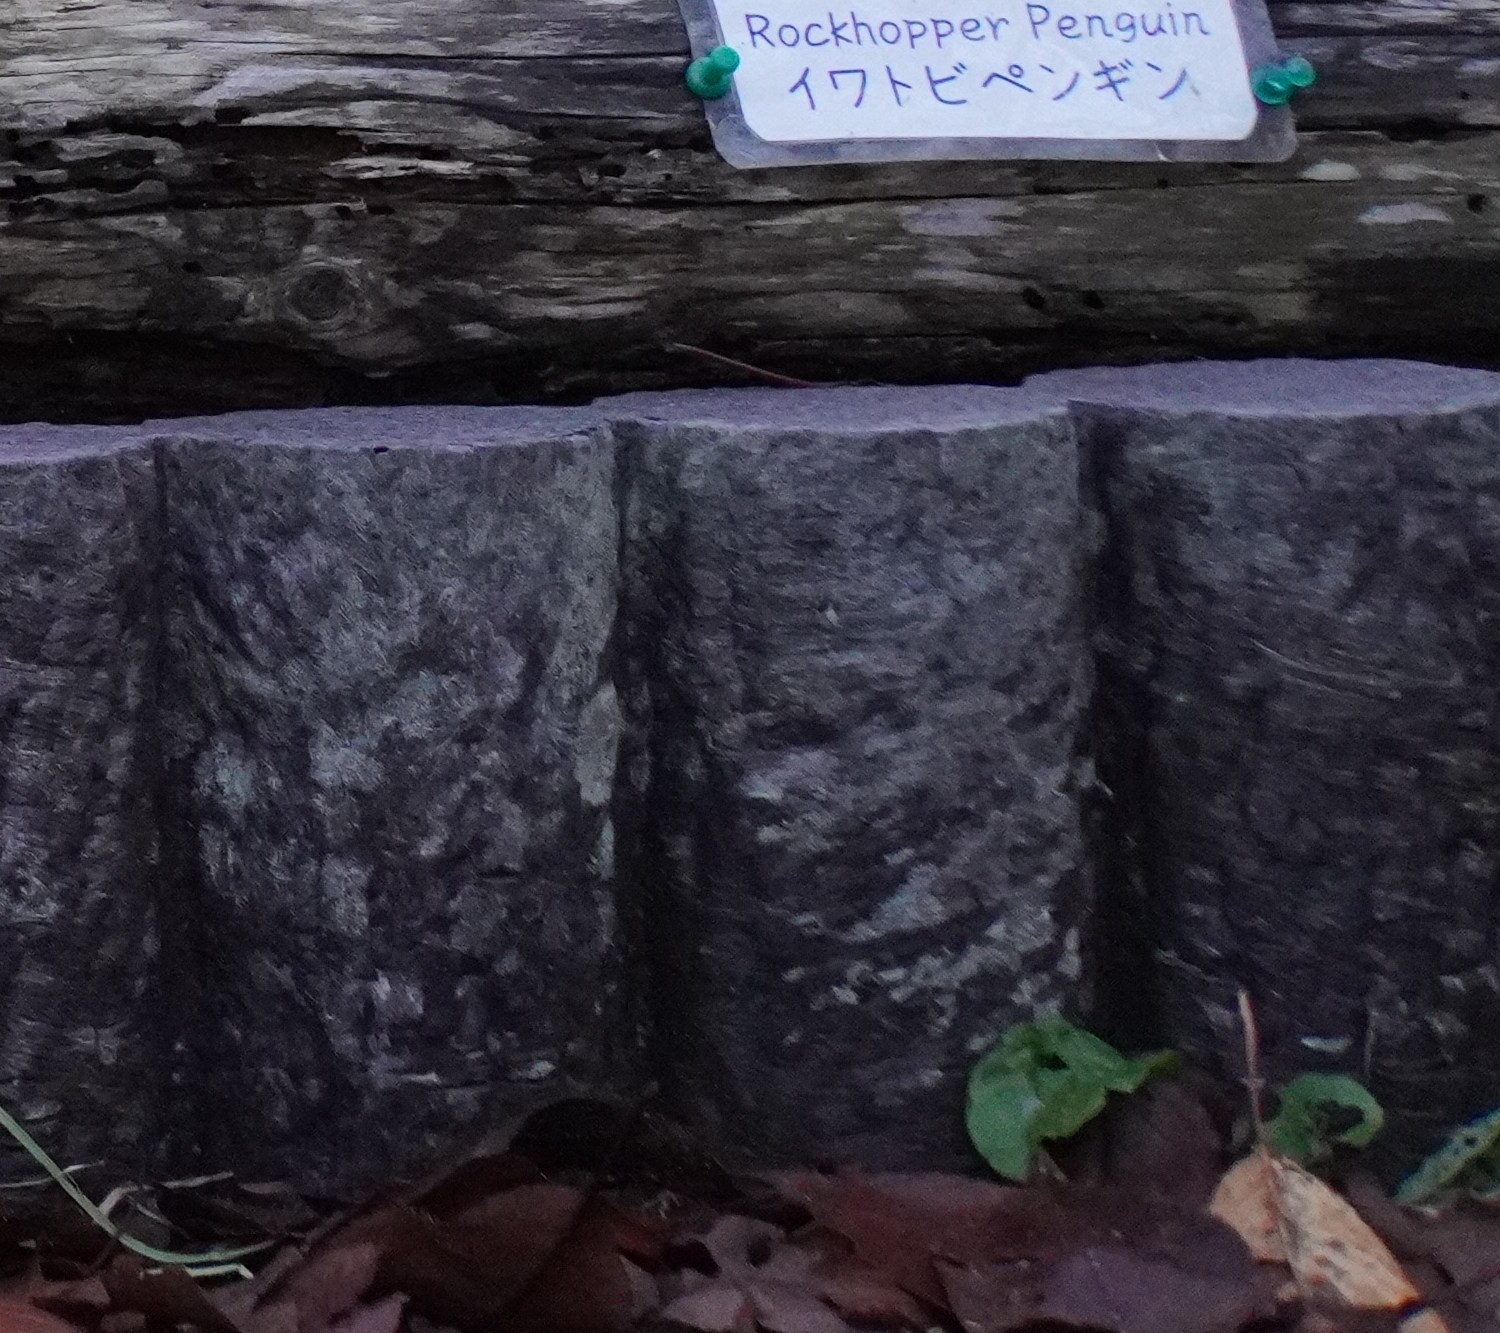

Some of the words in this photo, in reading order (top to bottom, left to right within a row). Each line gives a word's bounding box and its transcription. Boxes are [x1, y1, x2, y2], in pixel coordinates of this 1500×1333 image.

[745, 10, 1010, 52] Rockhopper
[1025, 2, 1212, 45] Penguin
[788, 58, 1189, 111] イワトビペンギン
